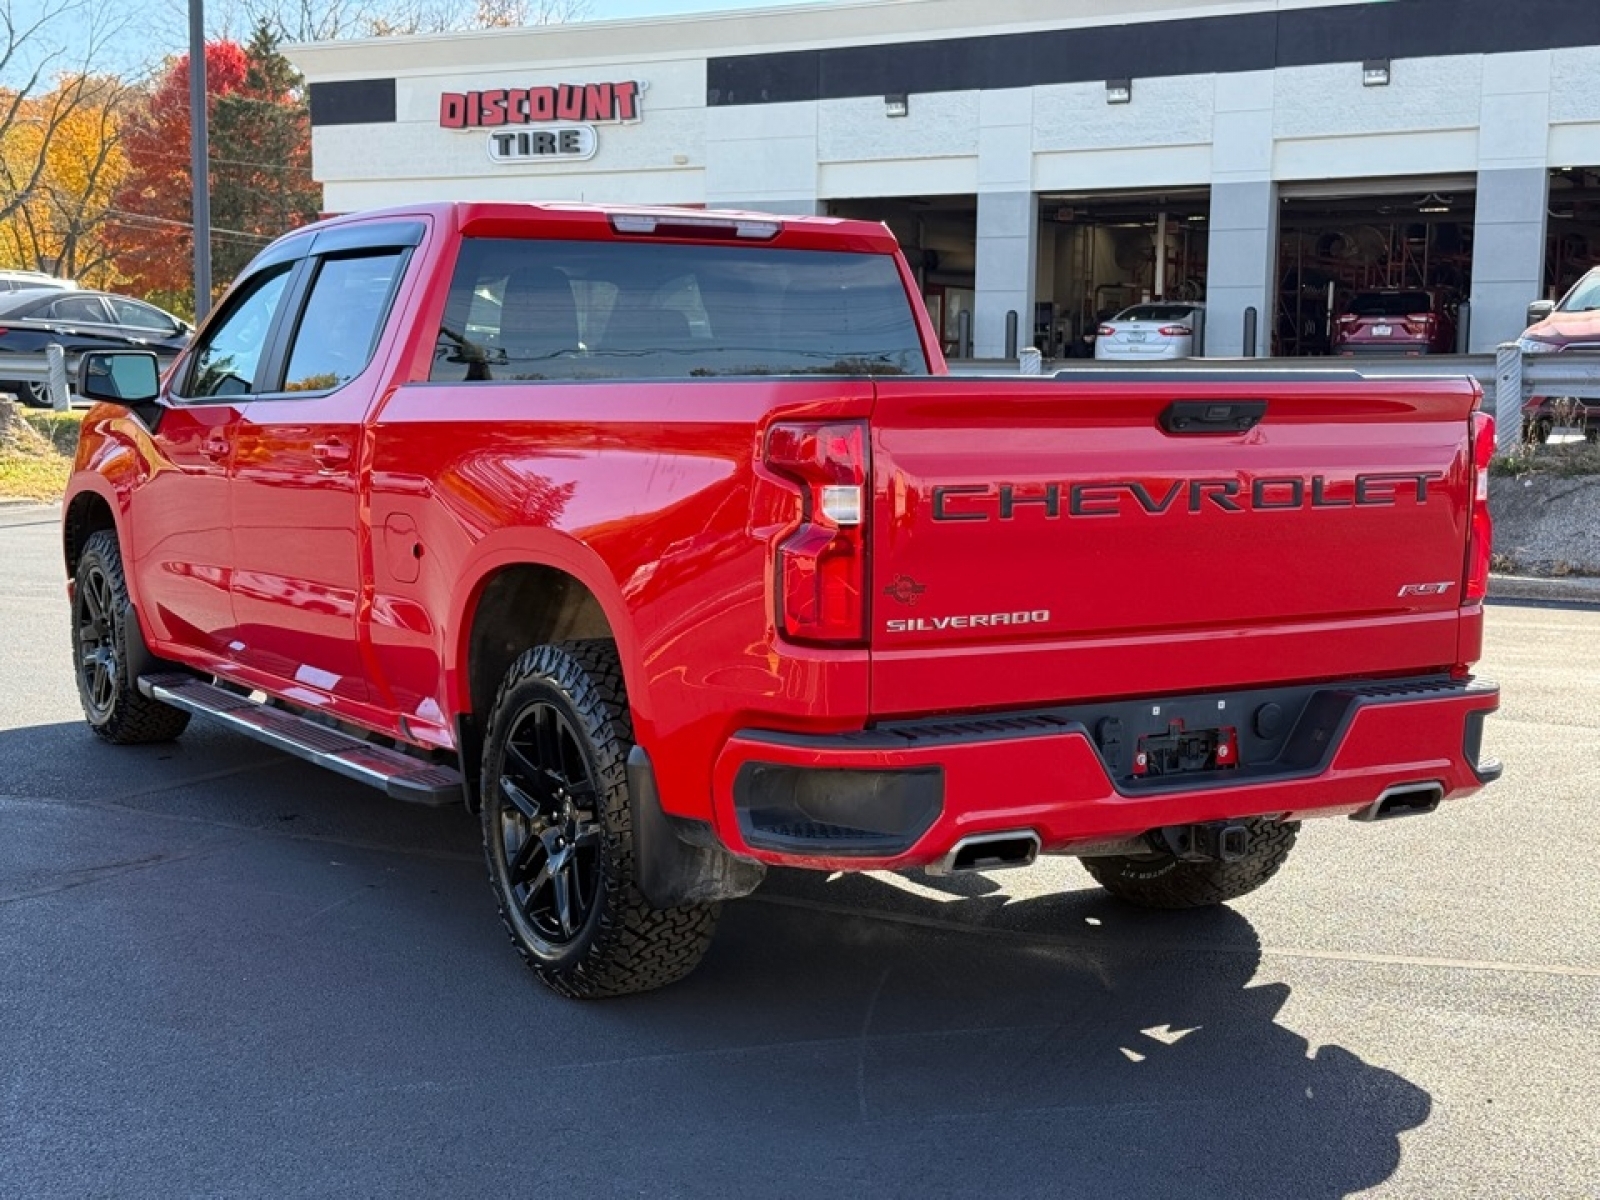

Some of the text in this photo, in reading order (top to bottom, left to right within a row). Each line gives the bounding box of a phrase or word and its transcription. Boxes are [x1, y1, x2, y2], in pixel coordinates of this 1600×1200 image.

[440, 80, 638, 128] DISCOUNT
[493, 130, 581, 156] TIRE
[931, 471, 1443, 522] CHEVROLET
[1397, 581, 1456, 598] RST
[886, 609, 1050, 633] SILVERADO
